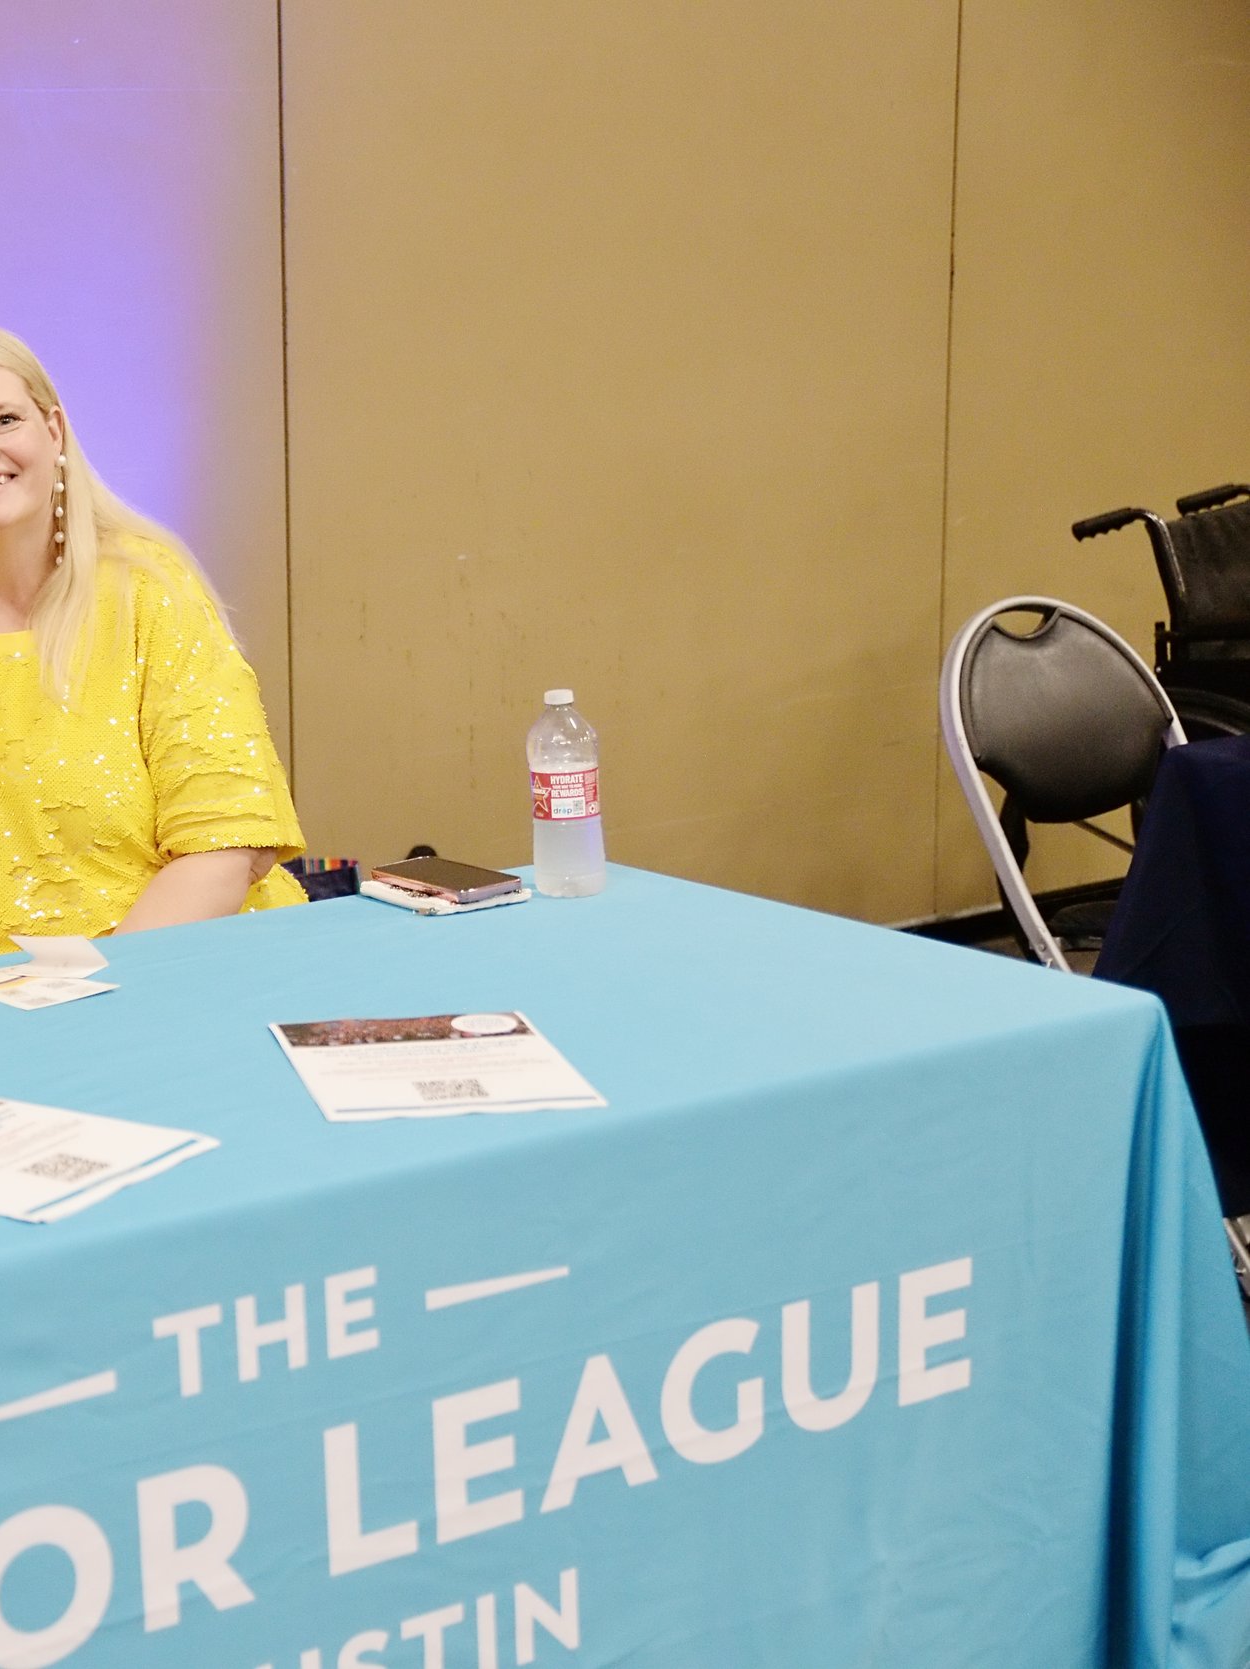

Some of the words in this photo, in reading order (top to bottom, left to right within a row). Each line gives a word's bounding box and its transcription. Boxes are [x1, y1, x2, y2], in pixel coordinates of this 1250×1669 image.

[550, 773, 584, 785] HYDRATE
[152, 1265, 380, 1397] THE
[323, 1257, 972, 1577] LEAGUE
[253, 1566, 580, 1668] STIN
